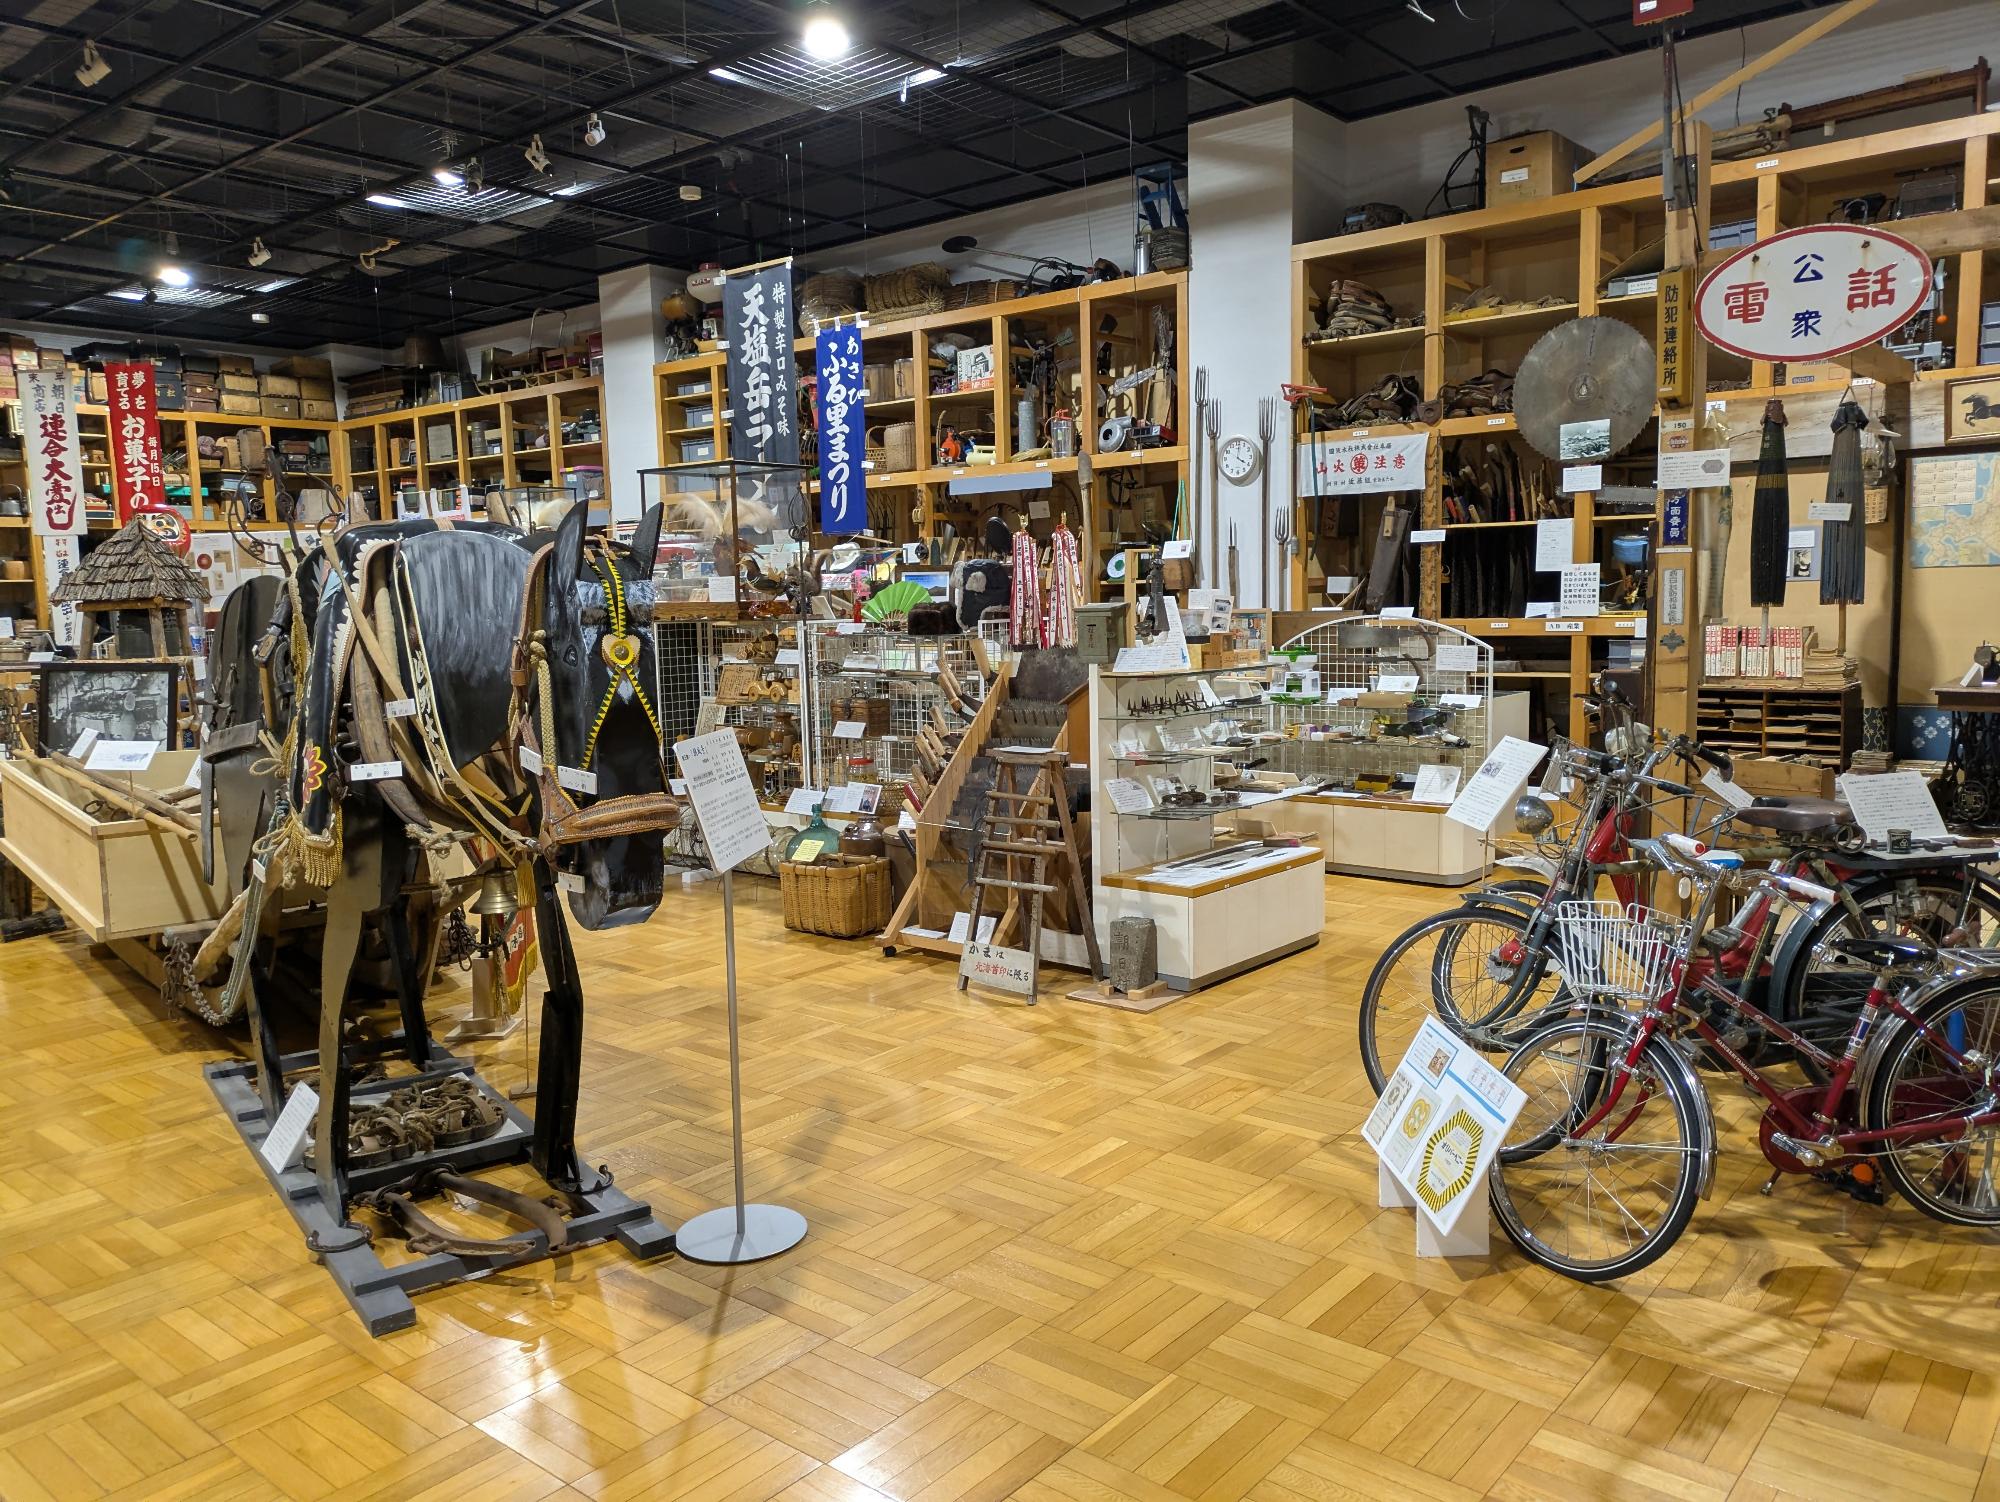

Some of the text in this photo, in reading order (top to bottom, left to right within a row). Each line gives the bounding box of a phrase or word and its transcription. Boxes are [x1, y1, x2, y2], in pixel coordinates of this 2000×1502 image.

[1791, 253, 1824, 338] 公衆
[771, 282, 791, 436] 特製辛口みそ味
[847, 337, 862, 404] あさひ
[1662, 285, 1680, 385] 防犯連絡所
[115, 371, 131, 410] 育てる
[132, 371, 147, 410] 夢を
[121, 414, 151, 509] お菓子の
[147, 437, 161, 487] 毎月15日
[822, 342, 852, 523] ふる里まつり
[968, 943, 1005, 960] かまは
